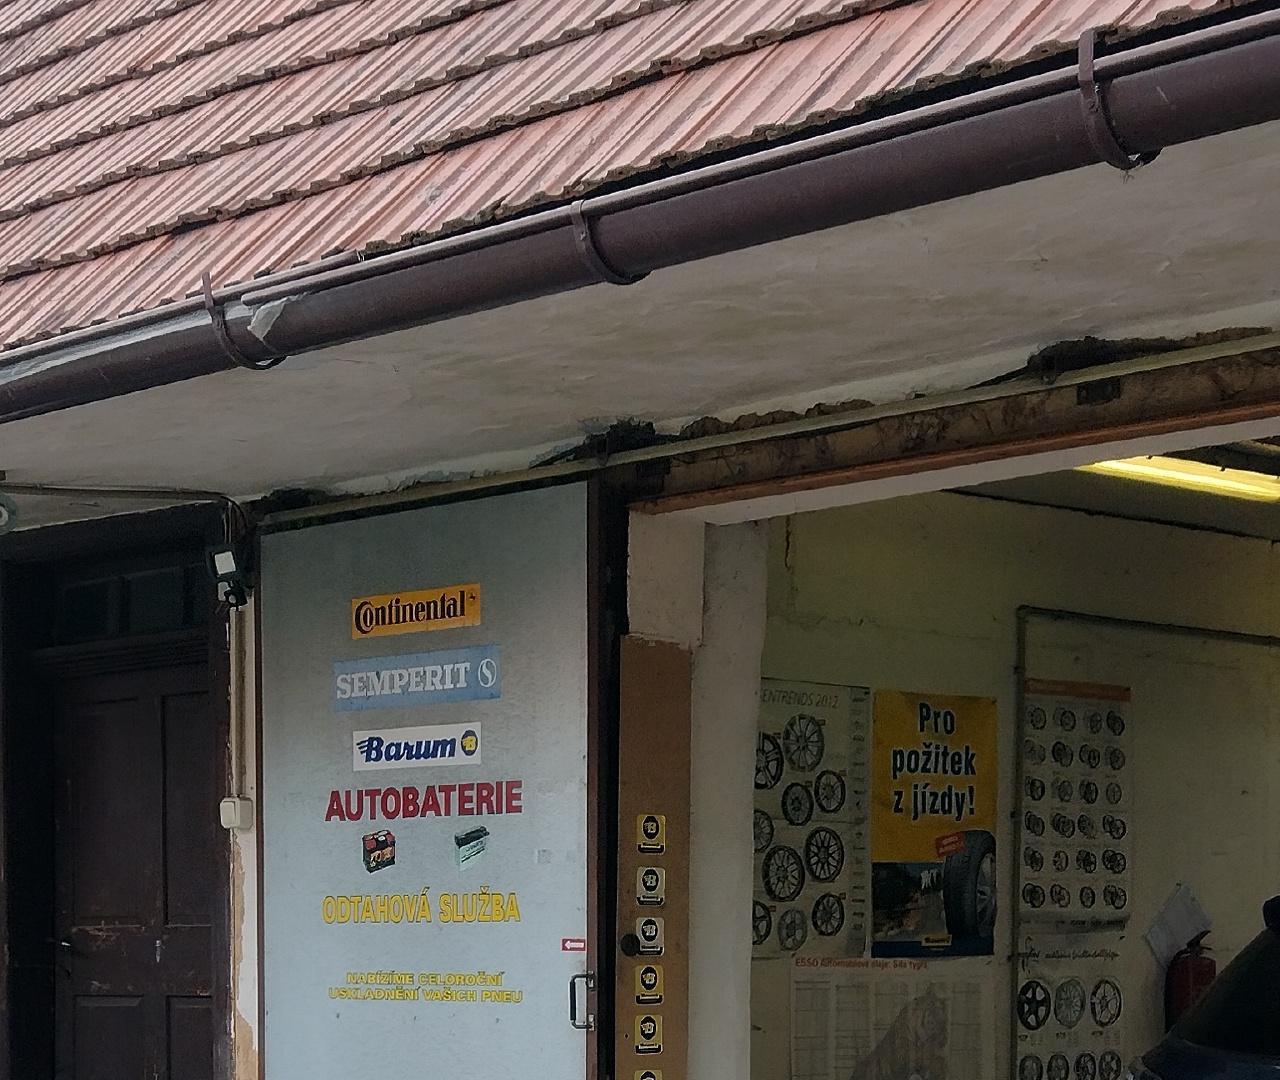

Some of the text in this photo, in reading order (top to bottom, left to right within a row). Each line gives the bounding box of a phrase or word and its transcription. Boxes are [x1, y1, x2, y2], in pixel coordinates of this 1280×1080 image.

[355, 590, 465, 634] Continental
[336, 663, 471, 698] SEMPERIT
[762, 689, 814, 706] ENTRENDS
[919, 702, 955, 735] Pro
[356, 737, 456, 763] Barum
[892, 742, 977, 780] požitek
[325, 780, 522, 821] AUTOBATERIE
[894, 783, 975, 821] z jízdy!
[323, 886, 521, 923] ODTAHOVÁ SLUŽBA
[328, 986, 522, 1003] USKLADNĚNÍ VAŠICH PNEU
[346, 970, 505, 986] NABÍZÍME CELOROČNÍ
